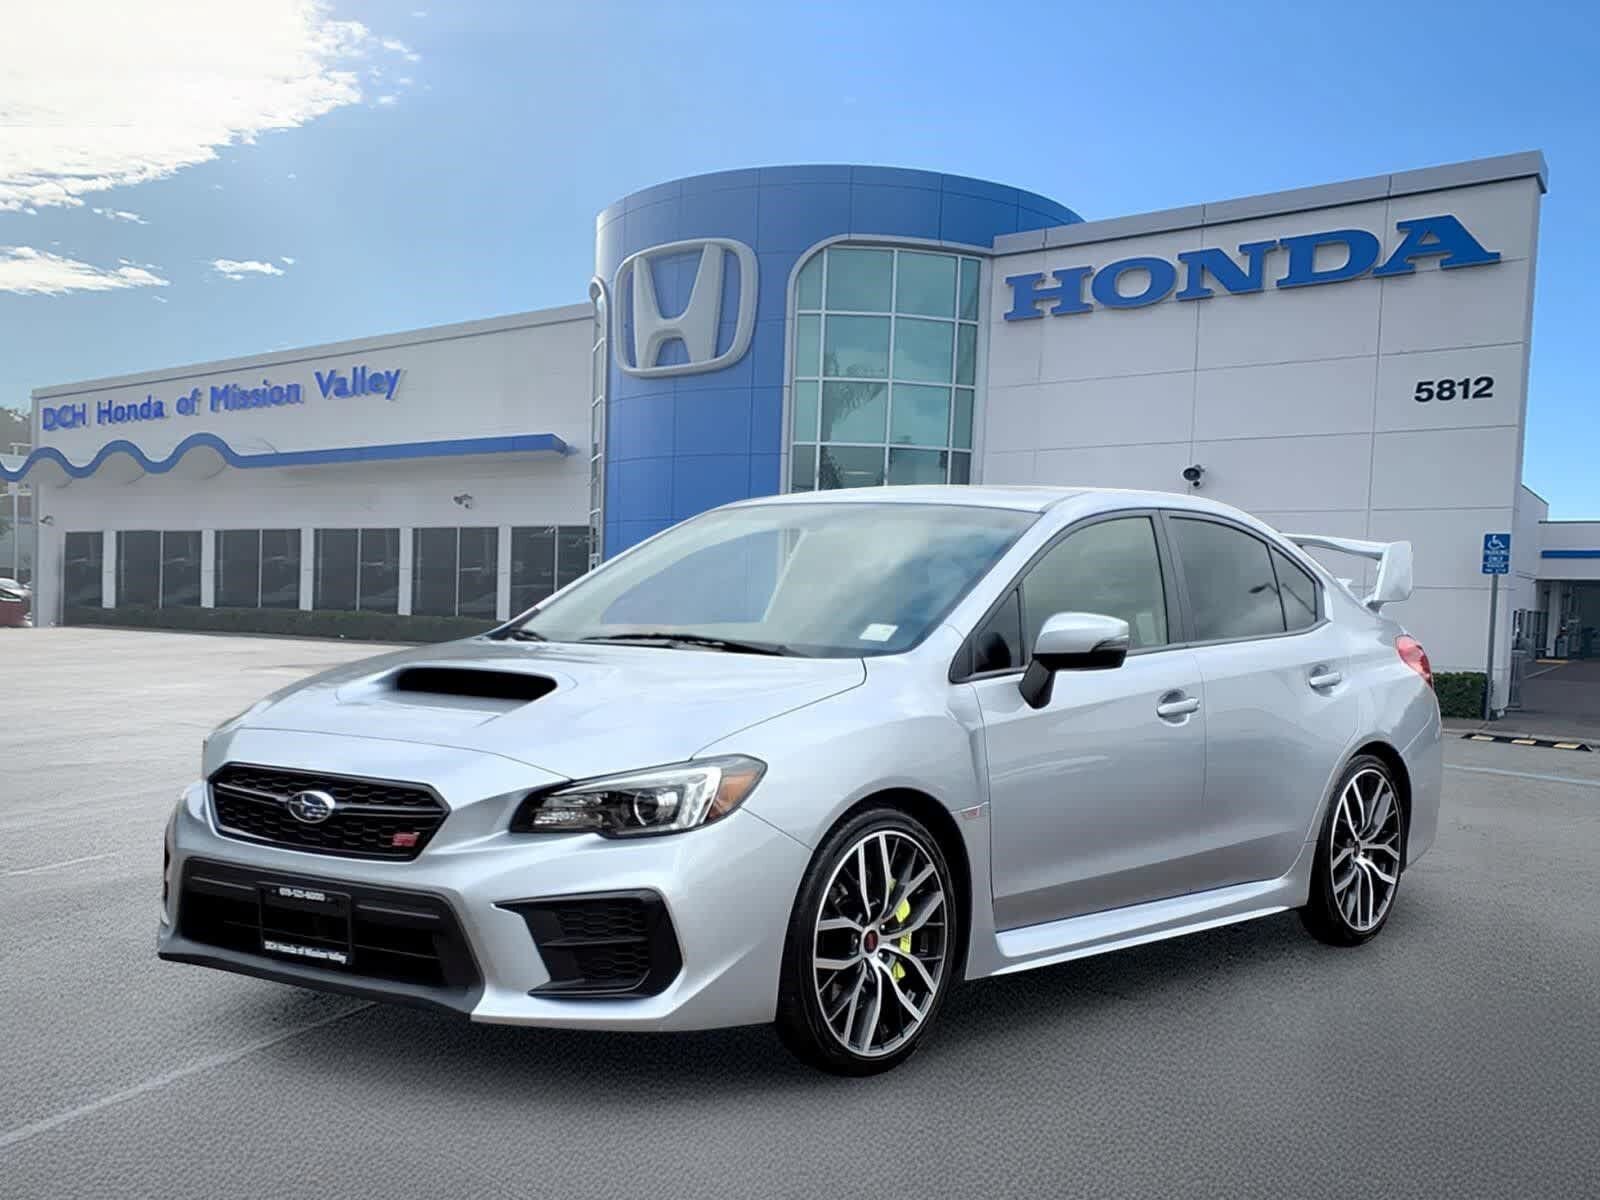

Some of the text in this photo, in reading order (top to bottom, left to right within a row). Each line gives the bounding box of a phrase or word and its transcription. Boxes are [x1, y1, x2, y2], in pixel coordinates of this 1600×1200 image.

[1004, 214, 1501, 322] HONDA
[42, 366, 404, 431] DCH Honda of Mission Valley
[1414, 376, 1495, 403] 5812
